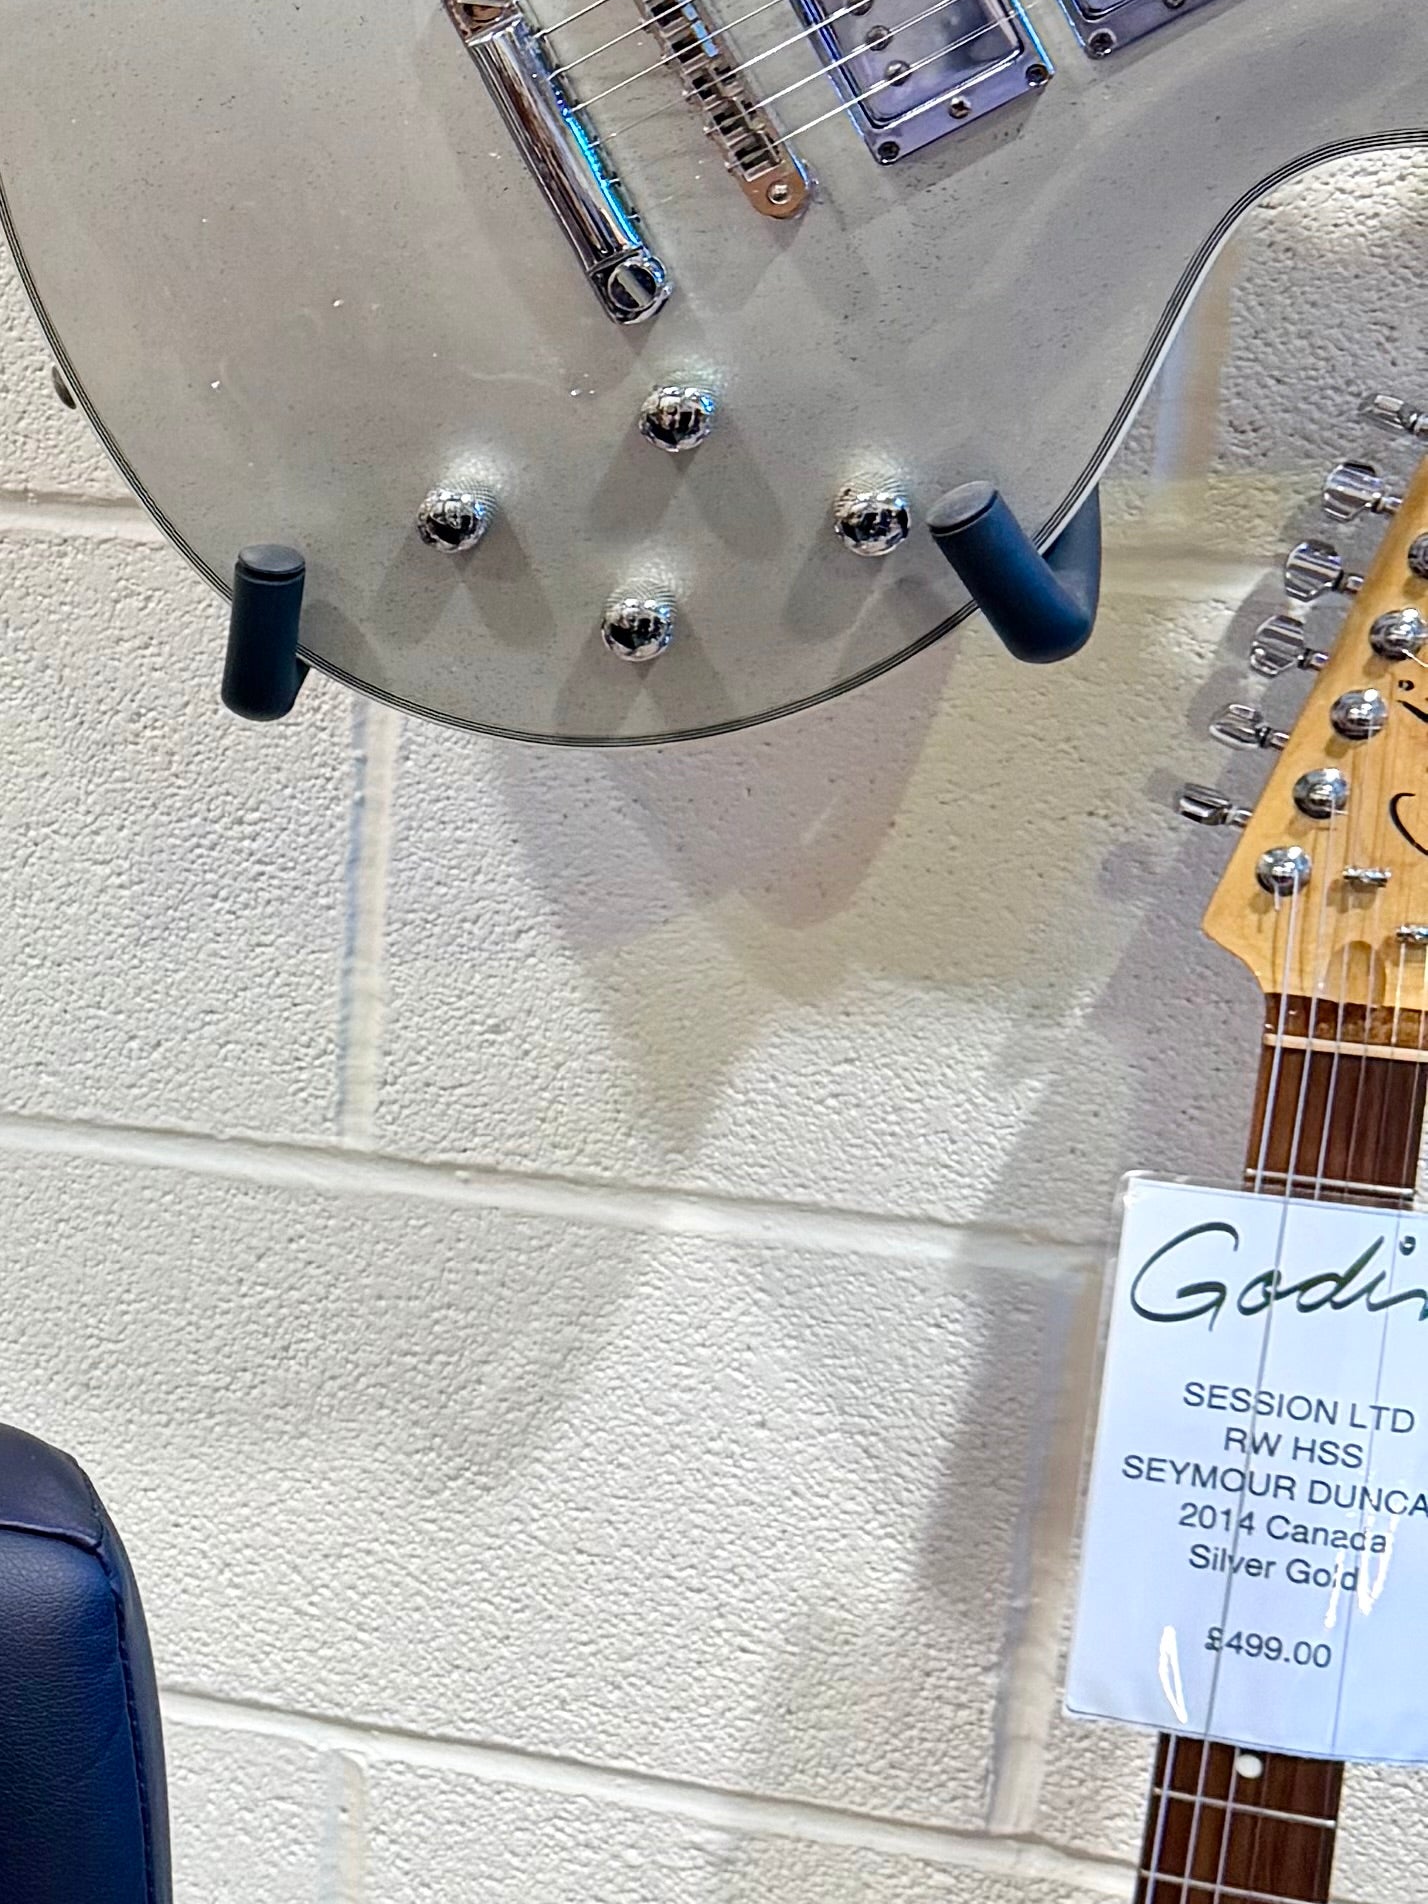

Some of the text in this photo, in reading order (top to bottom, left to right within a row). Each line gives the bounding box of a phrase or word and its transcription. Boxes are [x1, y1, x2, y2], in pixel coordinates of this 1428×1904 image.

[1183, 1382, 1415, 1434] SESSION LTD
[1224, 1427, 1364, 1469] RW HSS
[1122, 1455, 1296, 1500] SEYMOUR
[1178, 1503, 1387, 1554] 2014 Canada
[1189, 1544, 1276, 1580] Silver
[1205, 1627, 1331, 1668] £499.00
